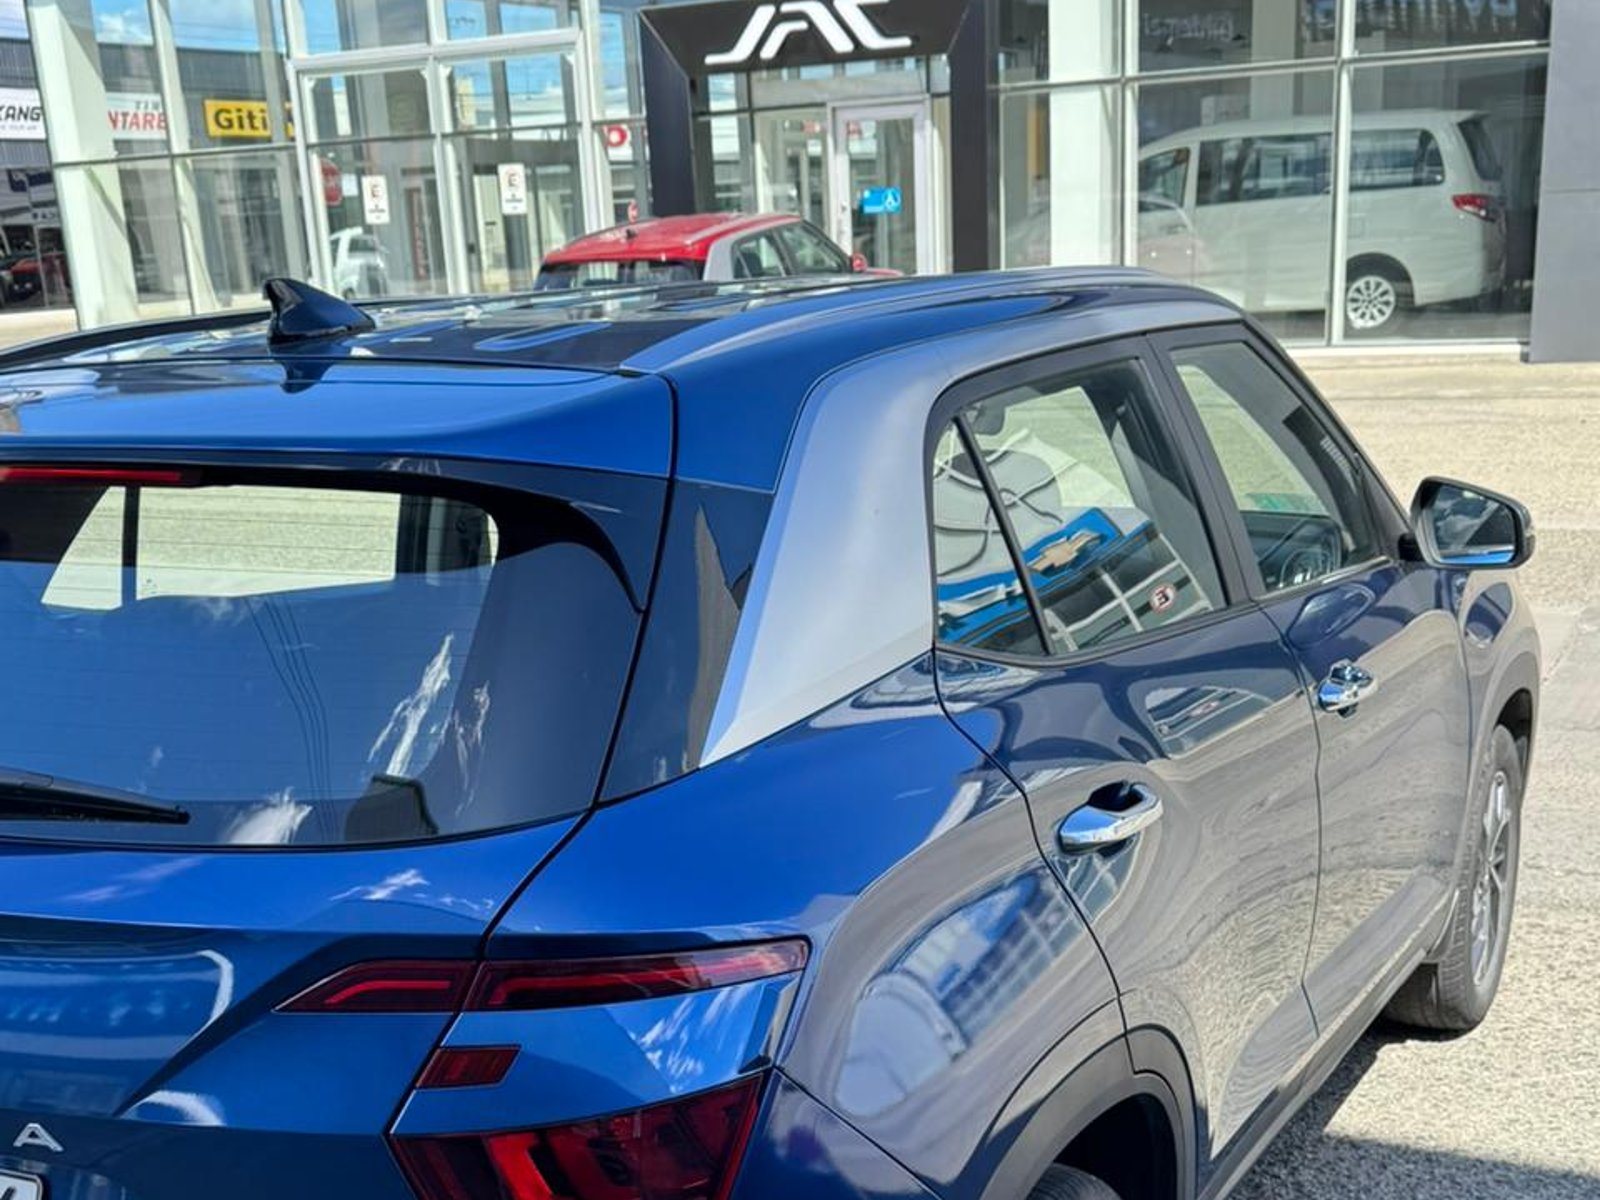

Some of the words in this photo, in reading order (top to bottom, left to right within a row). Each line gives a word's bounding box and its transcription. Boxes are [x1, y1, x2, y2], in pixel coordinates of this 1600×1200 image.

[704, 0, 912, 65] JAC
[214, 107, 268, 131] Giti
[13, 1122, 64, 1152] A
